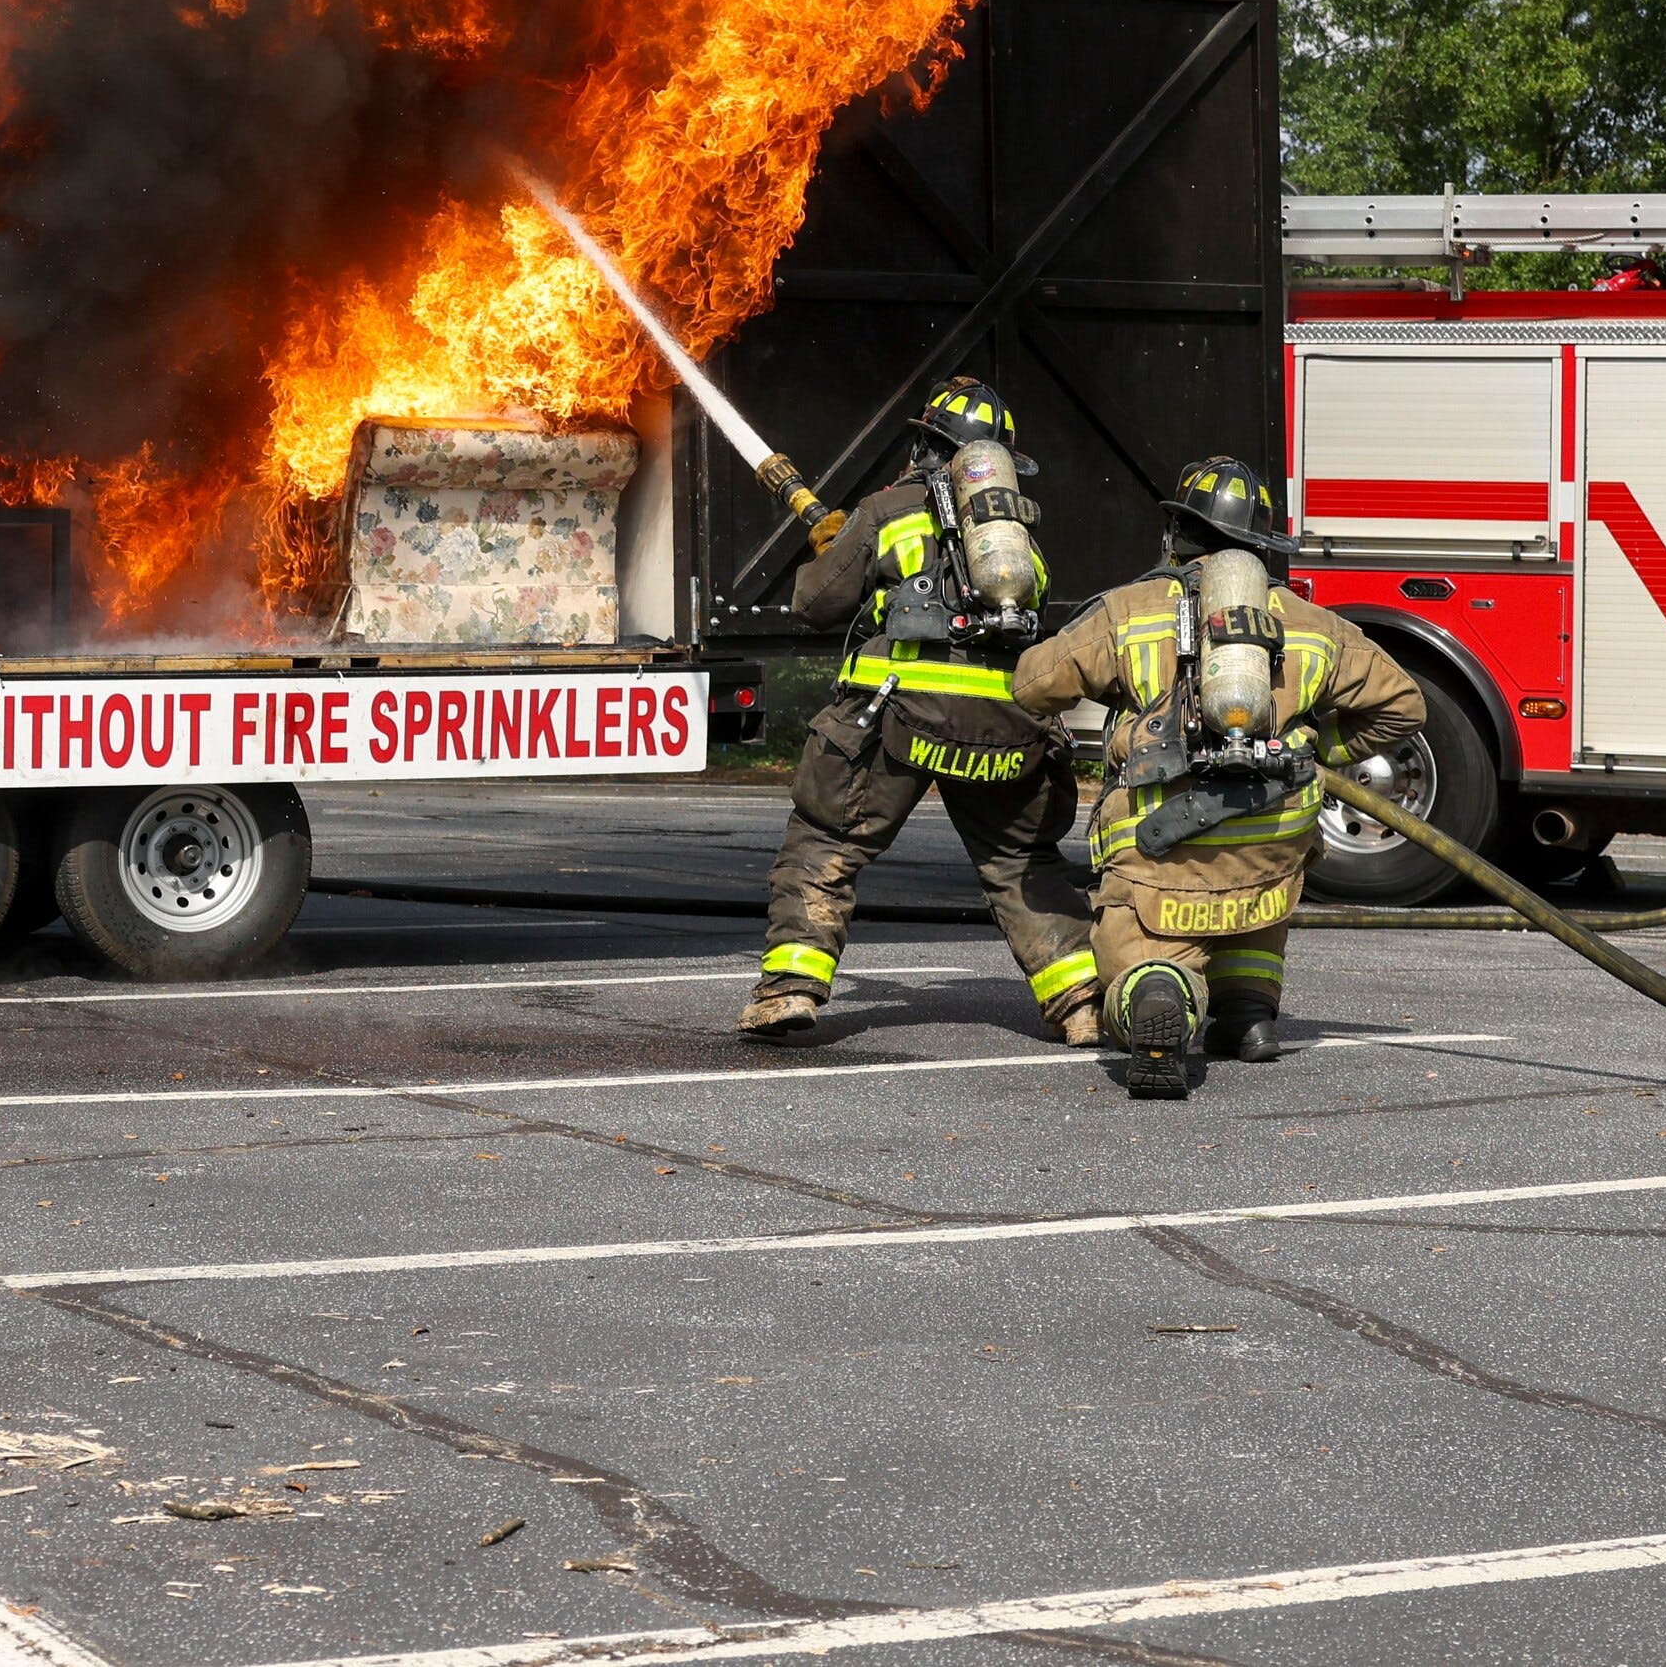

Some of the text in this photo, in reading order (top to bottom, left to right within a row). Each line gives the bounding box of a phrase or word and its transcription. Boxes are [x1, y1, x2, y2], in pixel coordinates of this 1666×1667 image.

[984, 490, 1035, 525] E10
[1221, 605, 1279, 640] E10
[233, 691, 349, 765] FIRE
[369, 685, 689, 764] SPRINKLERS
[909, 736, 1024, 782] WILLIAMS
[1159, 887, 1288, 932] ROBERTSON
